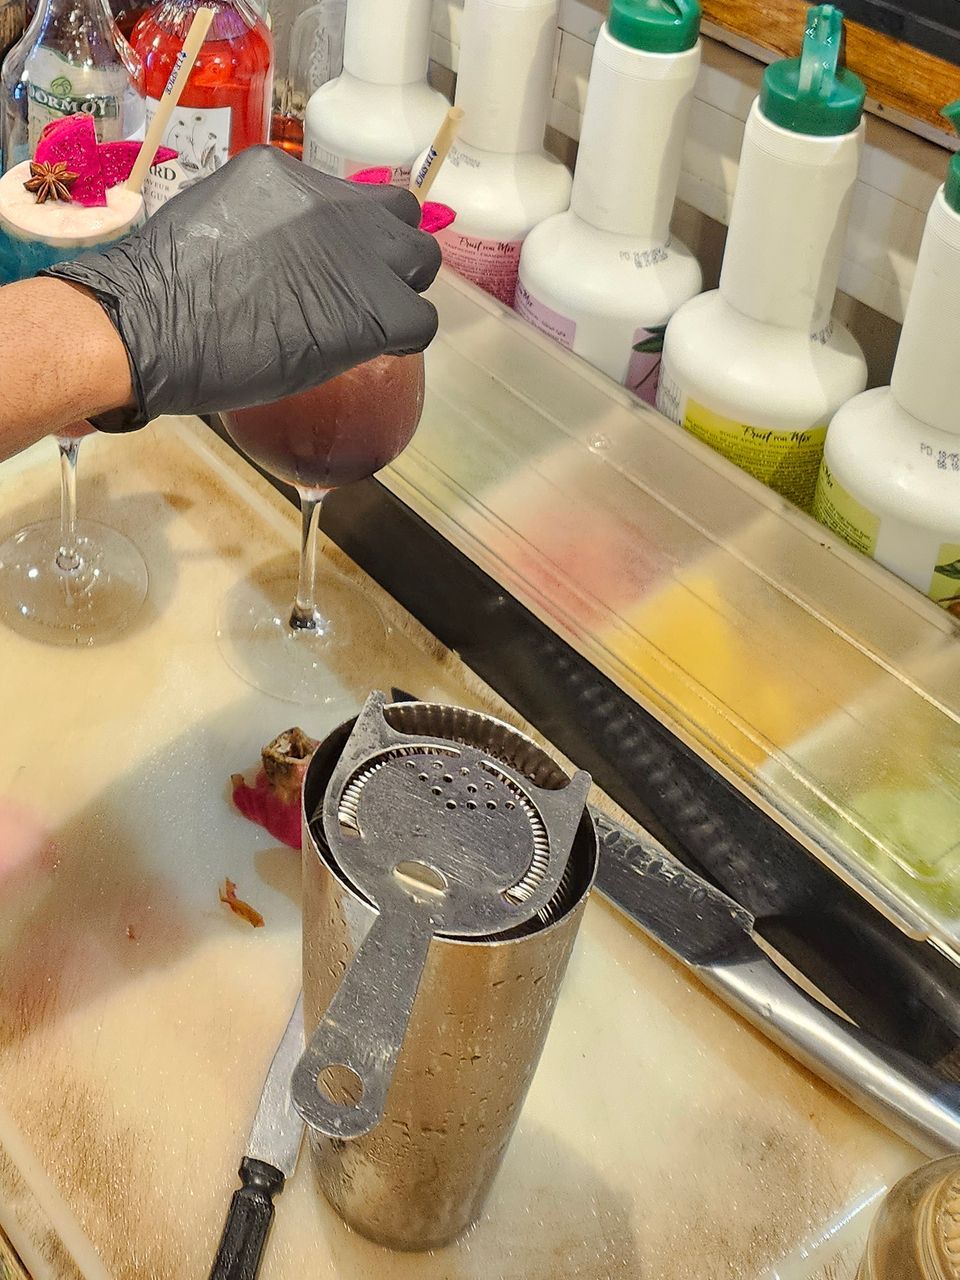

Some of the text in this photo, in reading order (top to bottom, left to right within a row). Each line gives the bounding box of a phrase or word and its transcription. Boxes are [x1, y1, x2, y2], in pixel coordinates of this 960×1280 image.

[28, 82, 107, 116] DORMOY
[497, 241, 516, 254] Mix
[741, 424, 773, 443] Fruit
[790, 431, 811, 449] Mix
